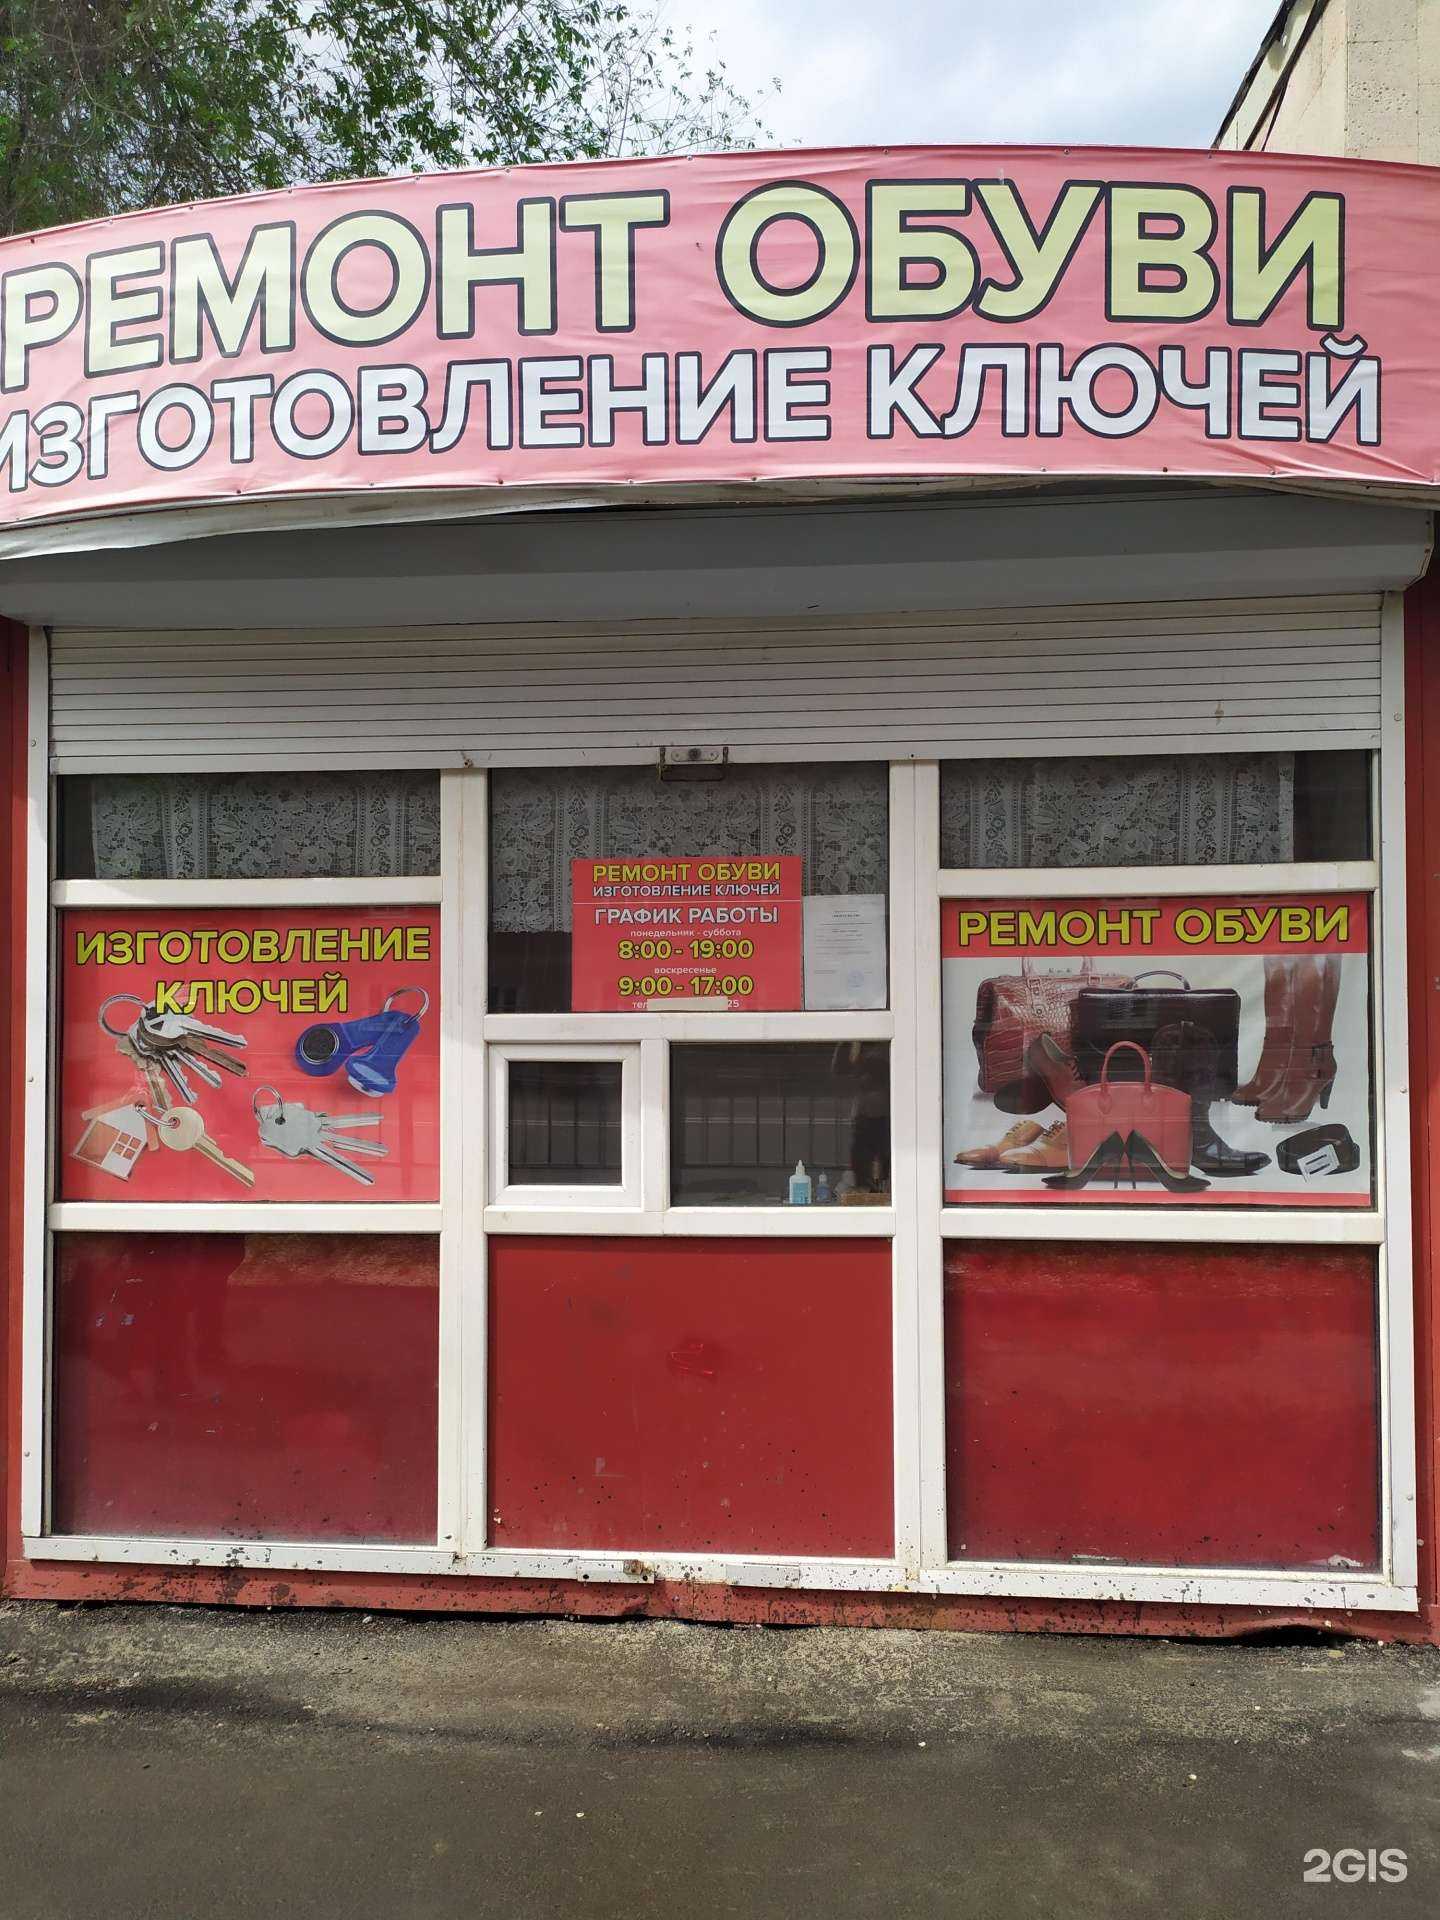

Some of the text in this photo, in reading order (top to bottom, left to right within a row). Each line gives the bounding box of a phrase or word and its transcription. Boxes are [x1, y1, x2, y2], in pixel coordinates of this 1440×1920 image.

[1, 178, 1345, 393] РЕМОНТ ОБУВИ
[867, 335, 1382, 447] КЛЮЧЕЙ
[593, 862, 781, 882] РЕМОНТ ОБУВИ
[593, 882, 781, 897] ИЗГОТОВЛЕНИЕ КЛЮЧЕЙ
[595, 906, 778, 924] ГРАФИК РАБОТЫ
[630, 929, 694, 938] понедельник
[703, 928, 741, 938] суббота
[959, 906, 1350, 947] РЕМОНТ ОБУВИ
[76, 926, 432, 965] ИЗГОТОВЛЕНИЕ
[618, 939, 672, 959] 8:00
[689, 939, 754, 959] 19:00
[654, 966, 717, 975] воскресенье
[154, 972, 348, 1014] КЛЮЧЕЙ
[618, 976, 672, 996] 9:00
[690, 975, 754, 996] 17:00
